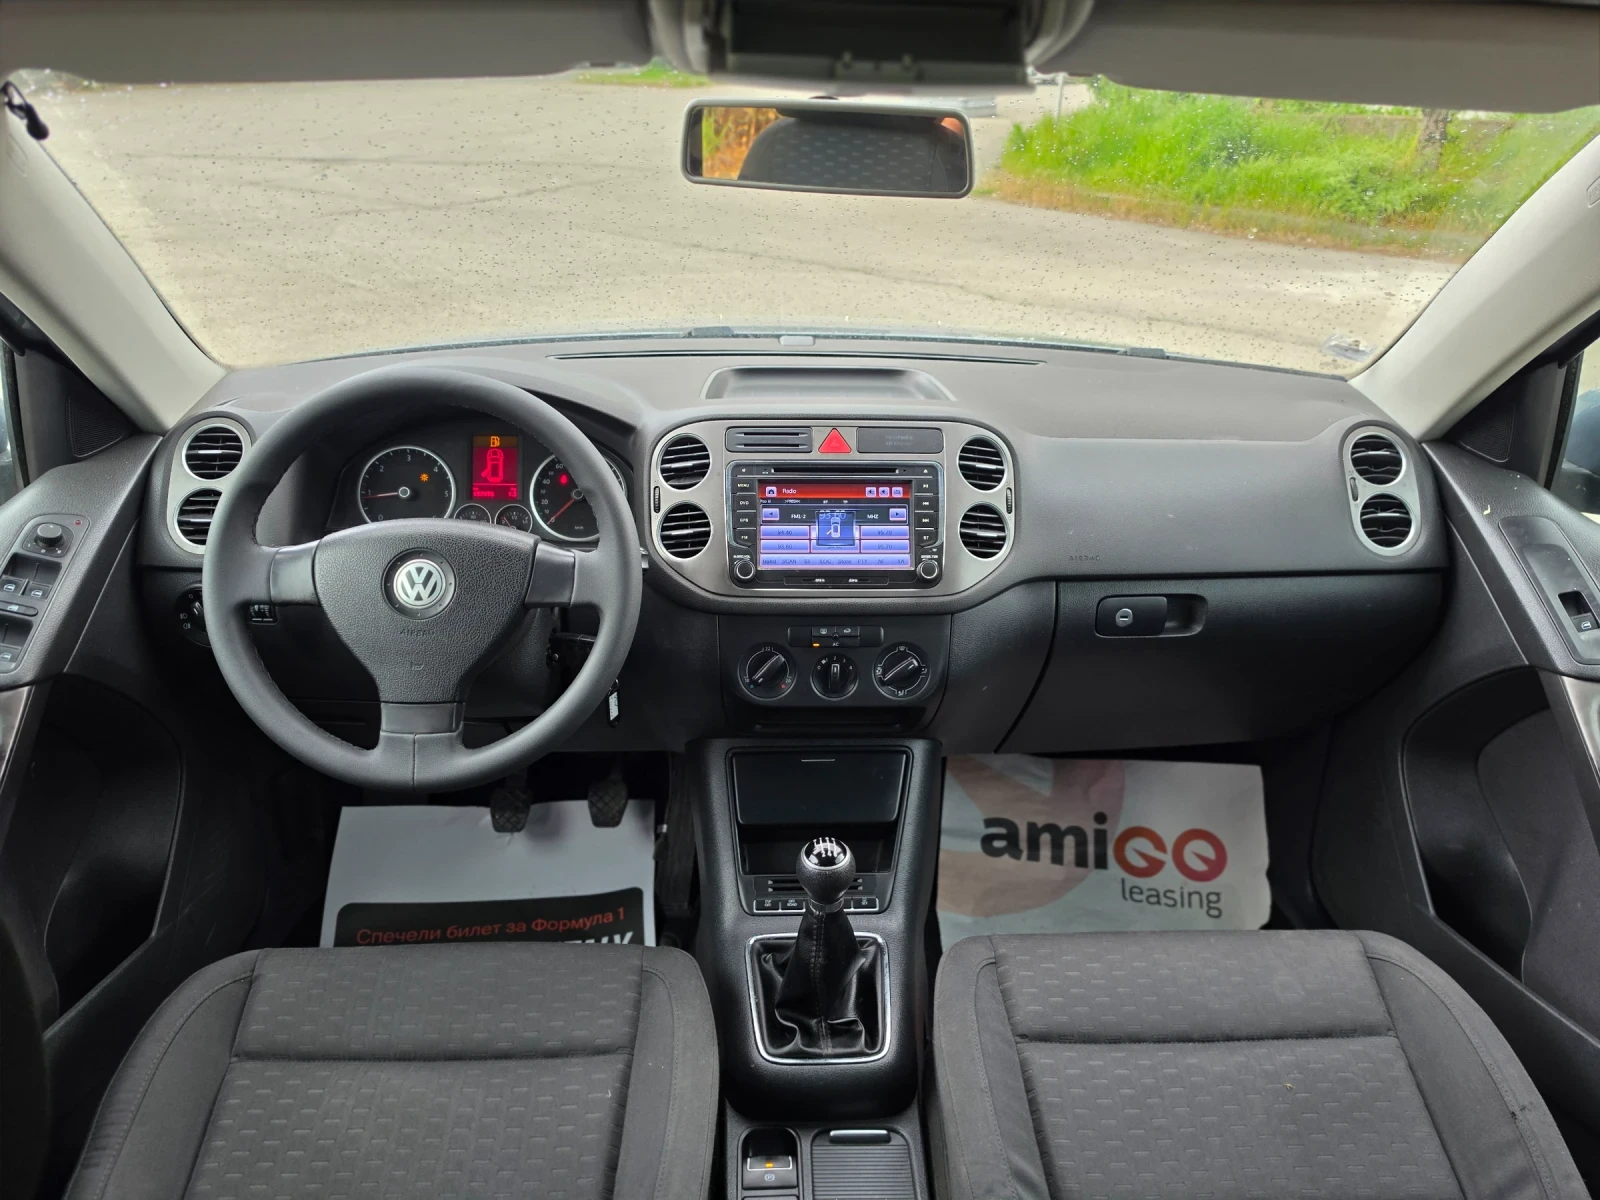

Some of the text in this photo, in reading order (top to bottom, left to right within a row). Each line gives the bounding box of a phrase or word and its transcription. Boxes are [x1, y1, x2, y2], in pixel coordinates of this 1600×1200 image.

[1120, 878, 1223, 919] leasing
[356, 907, 625, 945] Спечели билет за Формула 1
